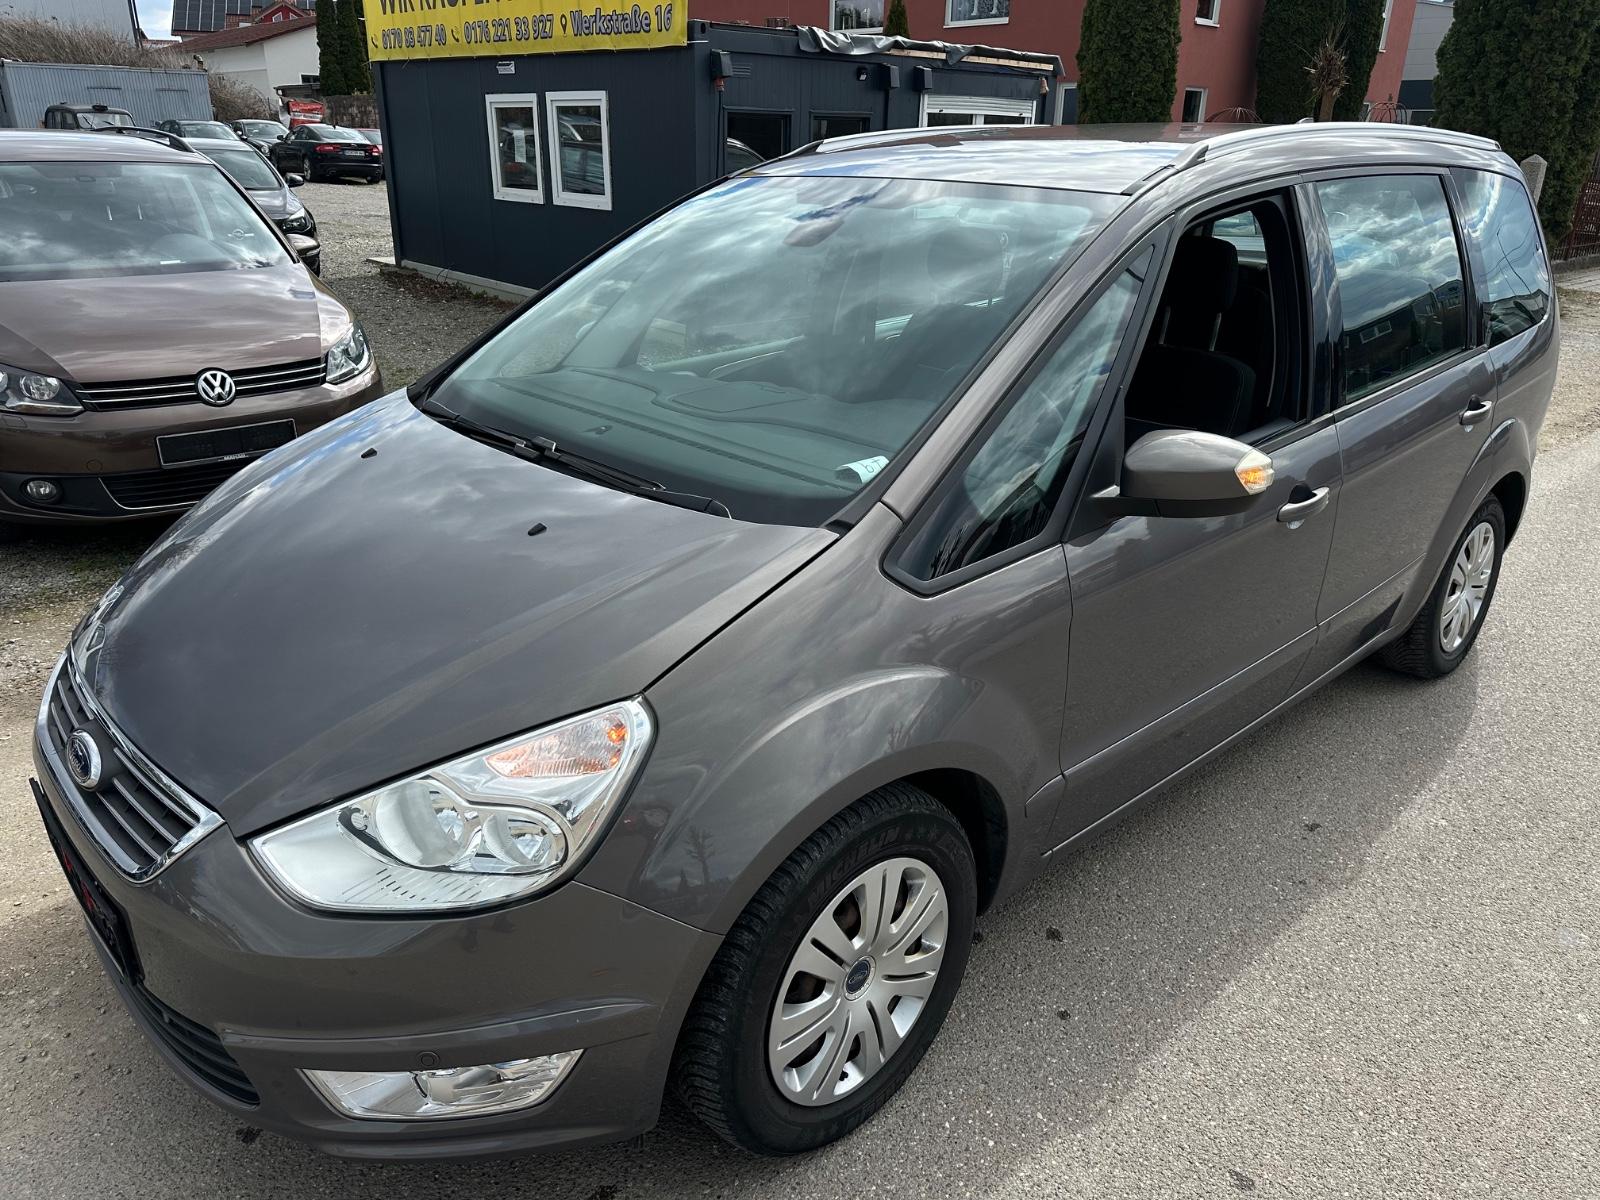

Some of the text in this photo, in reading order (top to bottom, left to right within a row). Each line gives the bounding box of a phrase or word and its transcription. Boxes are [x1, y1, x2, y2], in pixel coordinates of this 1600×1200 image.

[464, 20, 491, 44] 0176
[492, 17, 512, 42] 221
[514, 16, 530, 40] 33
[532, 13, 554, 40] 927
[570, 4, 651, 37] Werkstraße
[655, 3, 673, 32] 16
